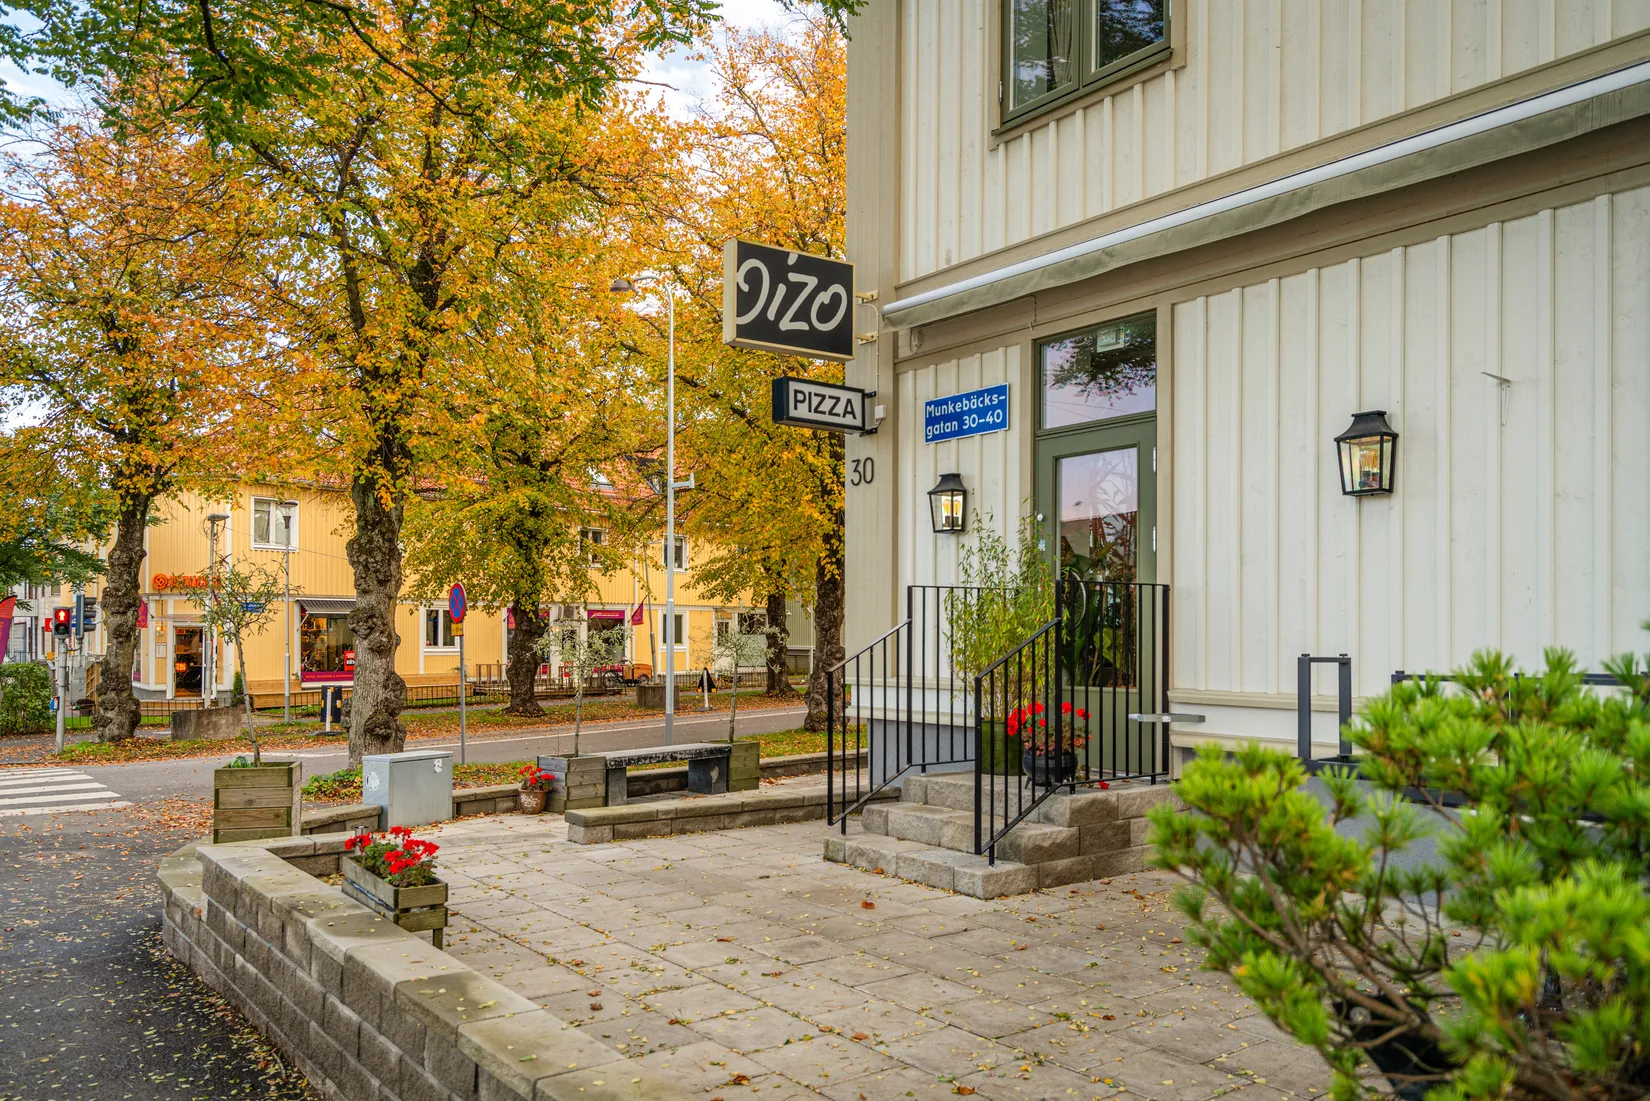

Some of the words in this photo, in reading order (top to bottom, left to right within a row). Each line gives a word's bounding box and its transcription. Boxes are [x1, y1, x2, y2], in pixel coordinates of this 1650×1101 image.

[793, 388, 857, 420] PIZZA
[926, 393, 1006, 419] Munkebäcks-
[926, 421, 958, 439] gatan
[962, 409, 1003, 429] 30-40
[850, 457, 875, 487] 30
